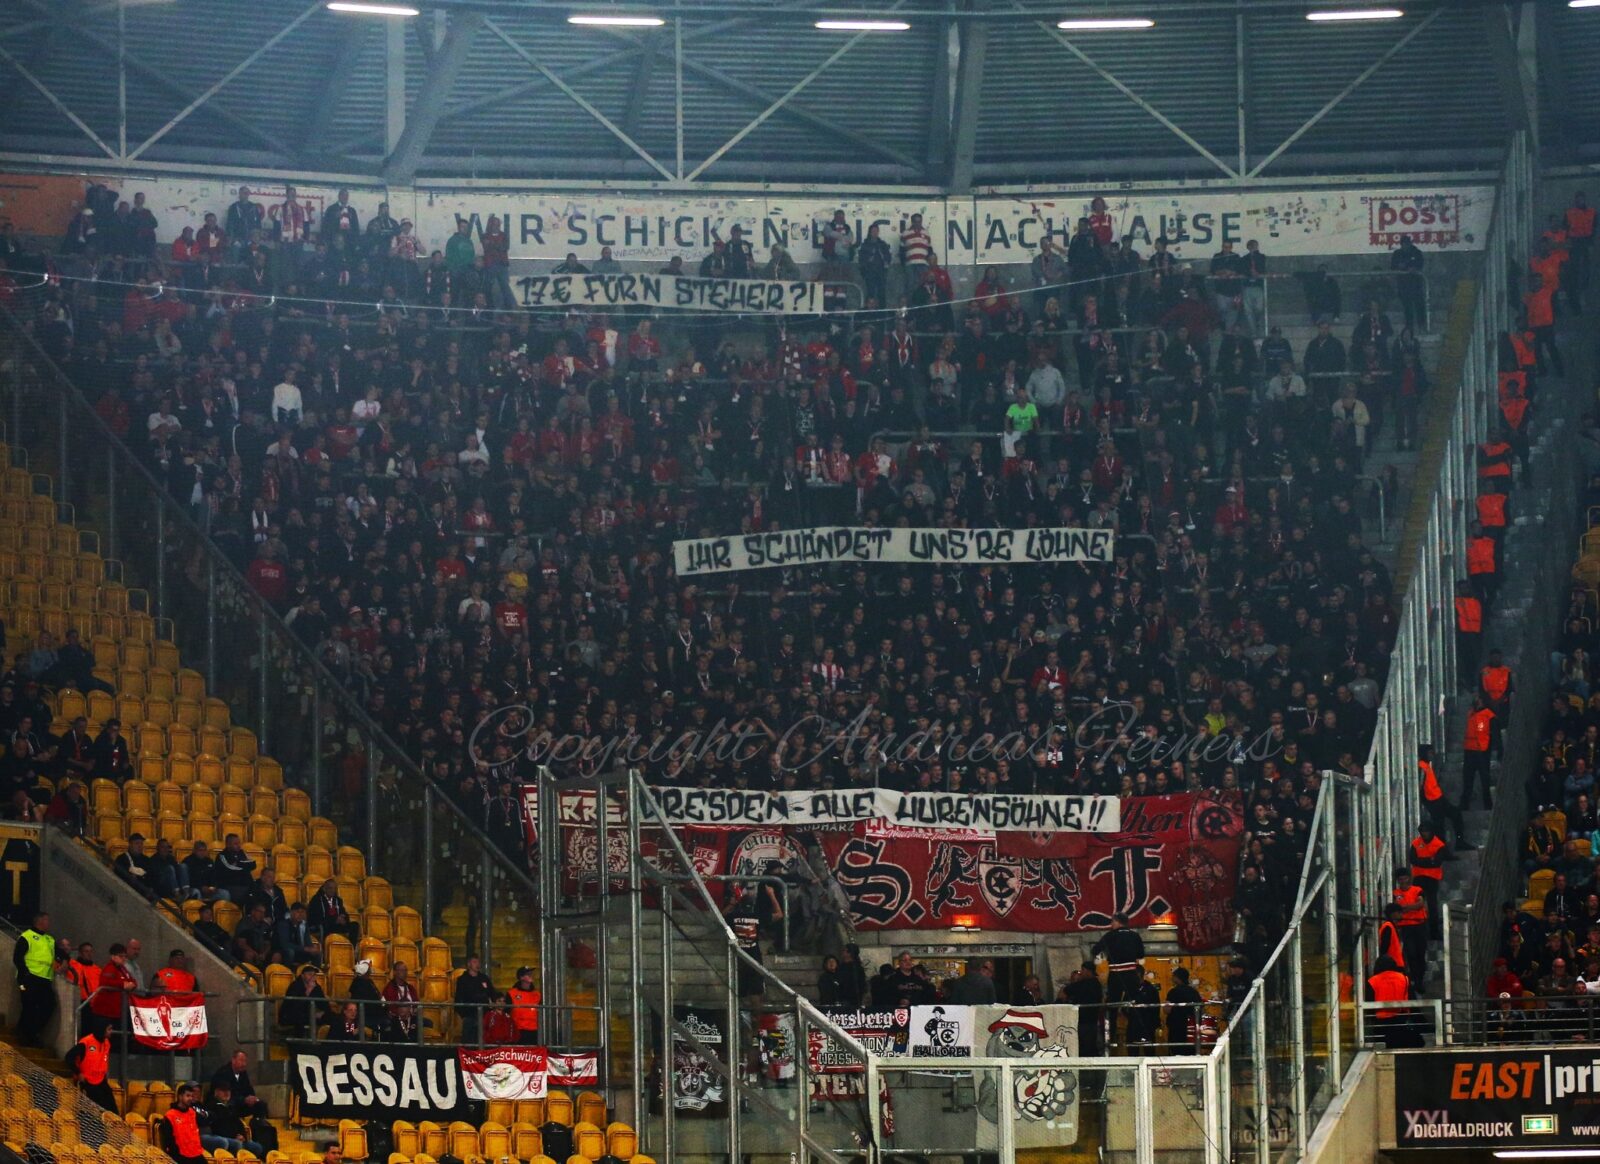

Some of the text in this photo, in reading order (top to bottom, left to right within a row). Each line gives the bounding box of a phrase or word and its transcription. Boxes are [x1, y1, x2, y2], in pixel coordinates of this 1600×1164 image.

[1378, 205, 1450, 231] post
[514, 276, 573, 307] 17€
[674, 280, 816, 312] STEHER?!
[687, 527, 1111, 573] IHR SCHÄNDET UNS'RE LÖHNE
[296, 1053, 457, 1110] DESSAU
[1450, 1061, 1540, 1100] EAST
[1413, 1122, 1514, 1138] DIGITALDRUCK
